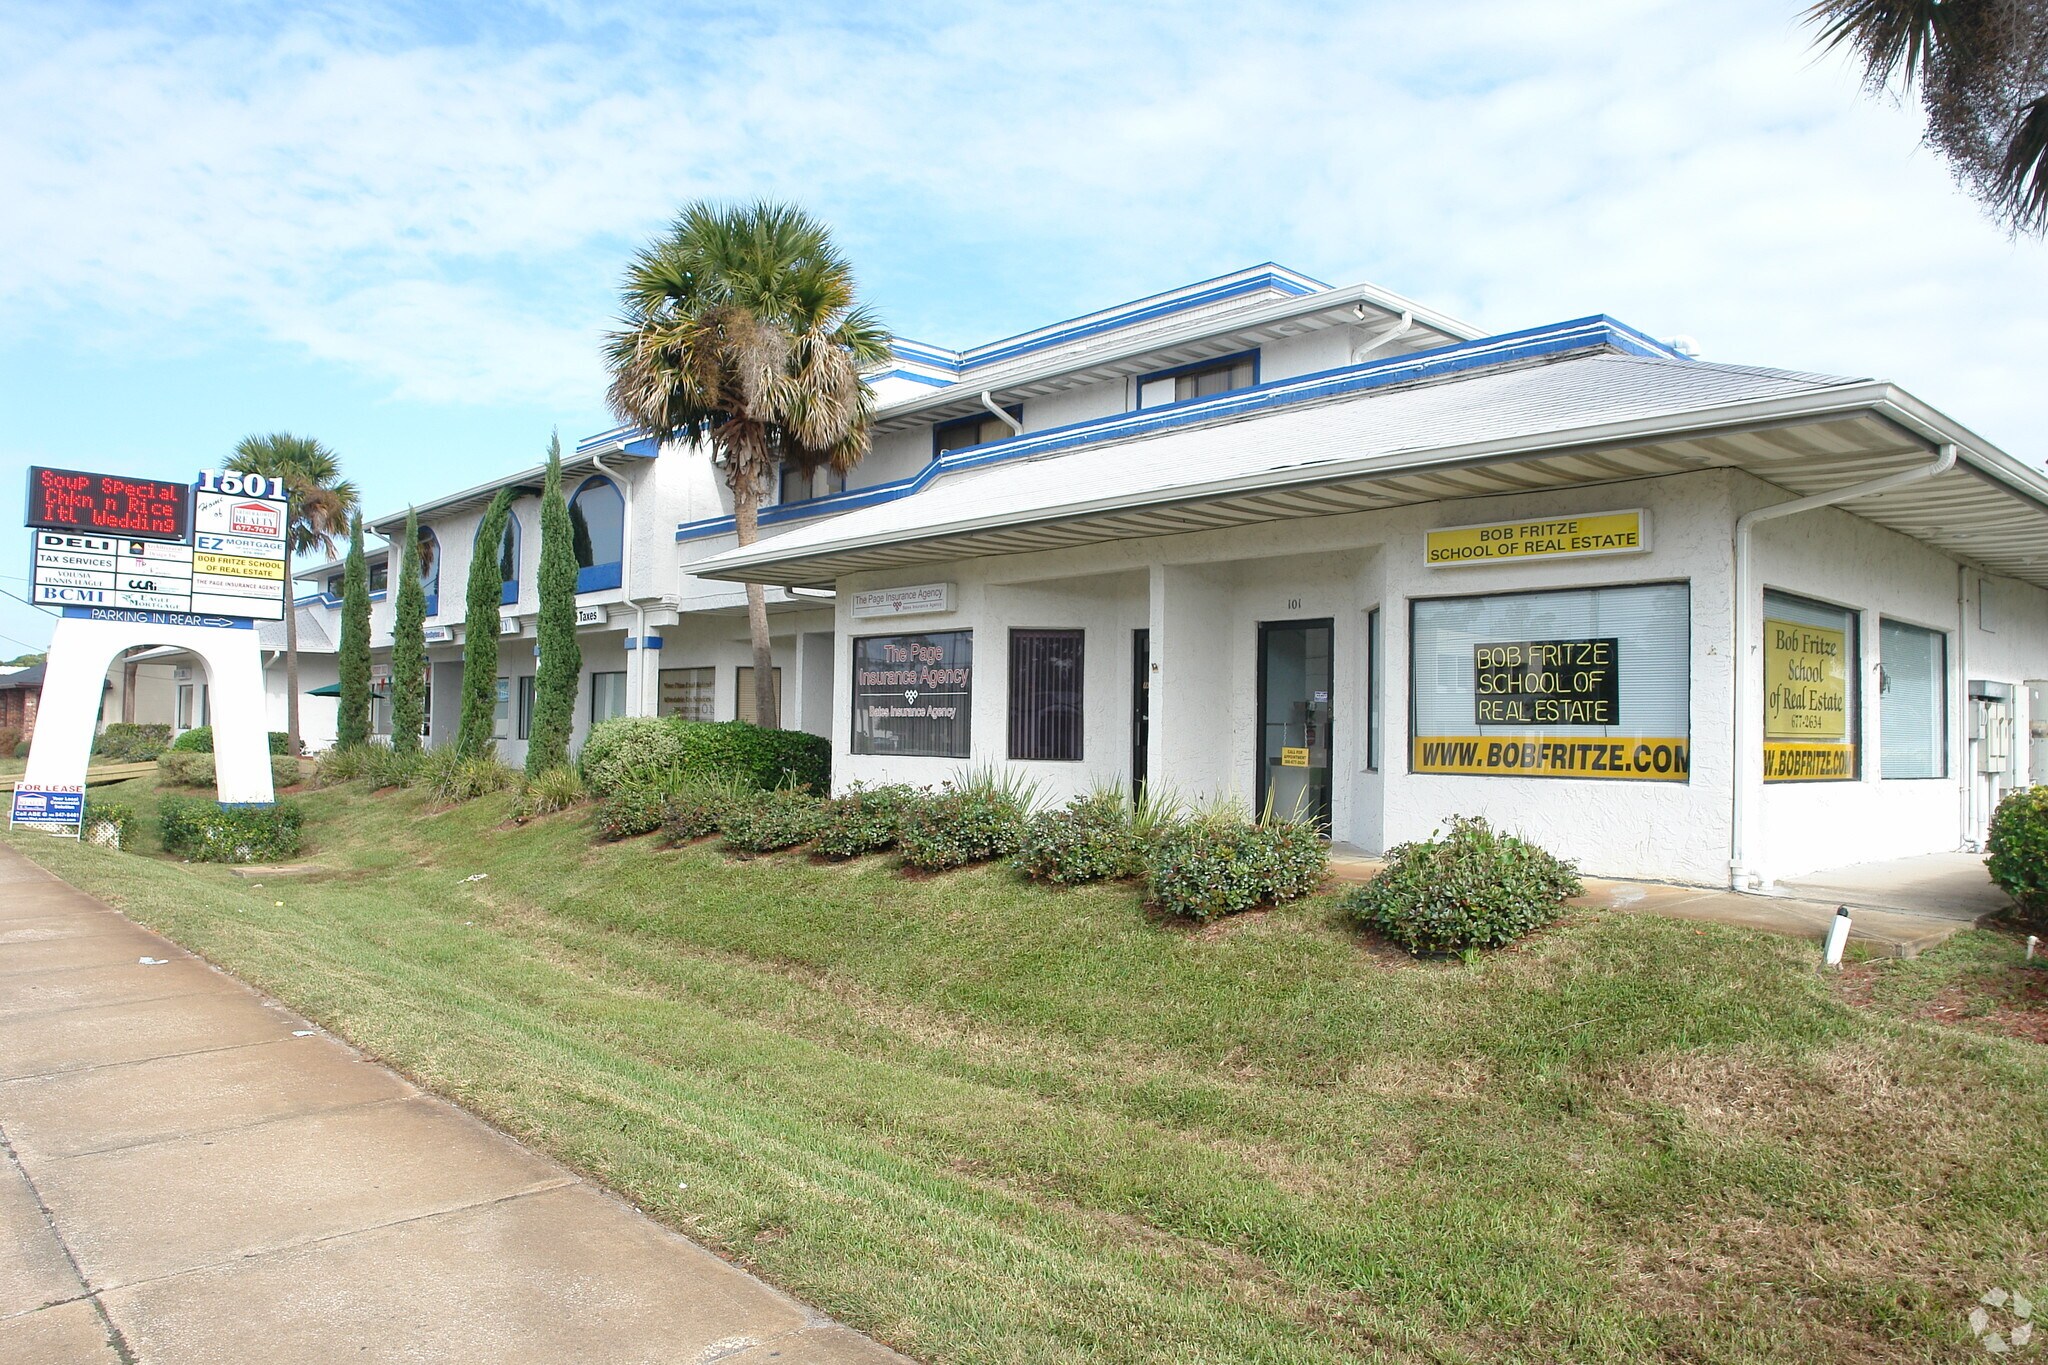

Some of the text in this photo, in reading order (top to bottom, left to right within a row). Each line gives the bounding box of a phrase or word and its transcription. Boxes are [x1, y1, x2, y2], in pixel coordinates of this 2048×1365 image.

[200, 469, 286, 500] 1501
[46, 488, 173, 516] Chkn n Rice
[92, 509, 175, 533] Wedding
[235, 515, 274, 527] REALTY
[1480, 522, 1578, 542] BOB FRITZE
[44, 535, 109, 550] DELI
[198, 536, 224, 550] EZ
[226, 539, 283, 550] MORTGAGE
[1430, 532, 1637, 562] SCHOOL OF REAL ESTATE
[40, 554, 112, 567] TAX SERVICES
[198, 555, 282, 569] BOB FRITZE SCHOOL
[58, 571, 91, 579] VOLUSIA
[220, 566, 241, 574] REAL
[243, 568, 273, 576] ESTATE
[225, 581, 257, 589] INSURANCE
[44, 587, 103, 602] BCMI
[856, 588, 943, 605] The Page Insurance Agency
[1288, 599, 1301, 610] 101
[91, 608, 201, 626] PARKING IN REAR
[579, 611, 597, 622] Taxes
[1776, 629, 1837, 657] Bob Fritze
[884, 643, 944, 666] The Page
[1477, 643, 1610, 670] BOB FRITZE
[859, 665, 969, 688] Insurance Agency
[1788, 657, 1824, 682] School
[1479, 670, 1606, 695] SCHOOL OF
[1769, 683, 1843, 719] of Real Estate
[890, 705, 926, 717] Insurance
[926, 705, 957, 720] Agency
[1479, 699, 1609, 722] REAL ESTATE
[1791, 714, 1822, 729] 677-2634
